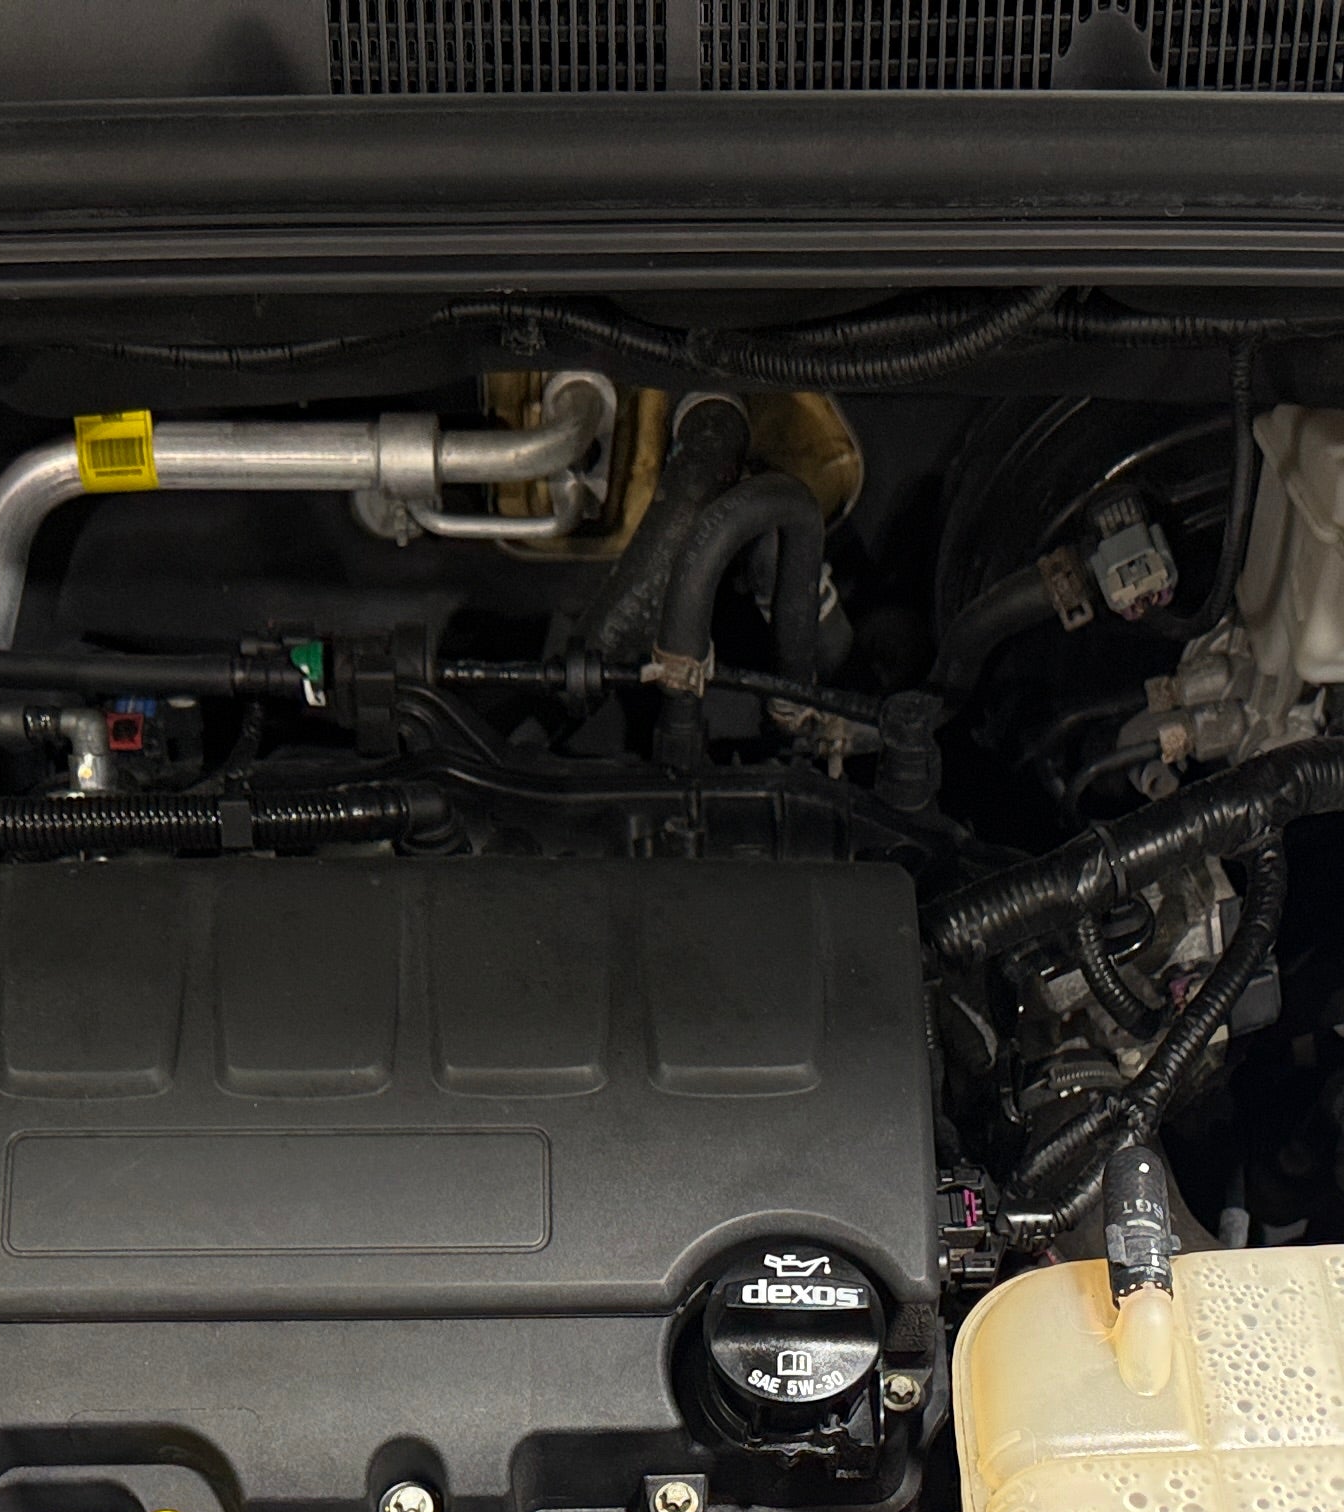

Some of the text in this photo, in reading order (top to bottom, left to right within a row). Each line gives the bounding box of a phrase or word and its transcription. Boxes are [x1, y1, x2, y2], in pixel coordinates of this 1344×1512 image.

[742, 1279, 859, 1306] dexos
[748, 1369, 844, 1396] SAE 5W-30
